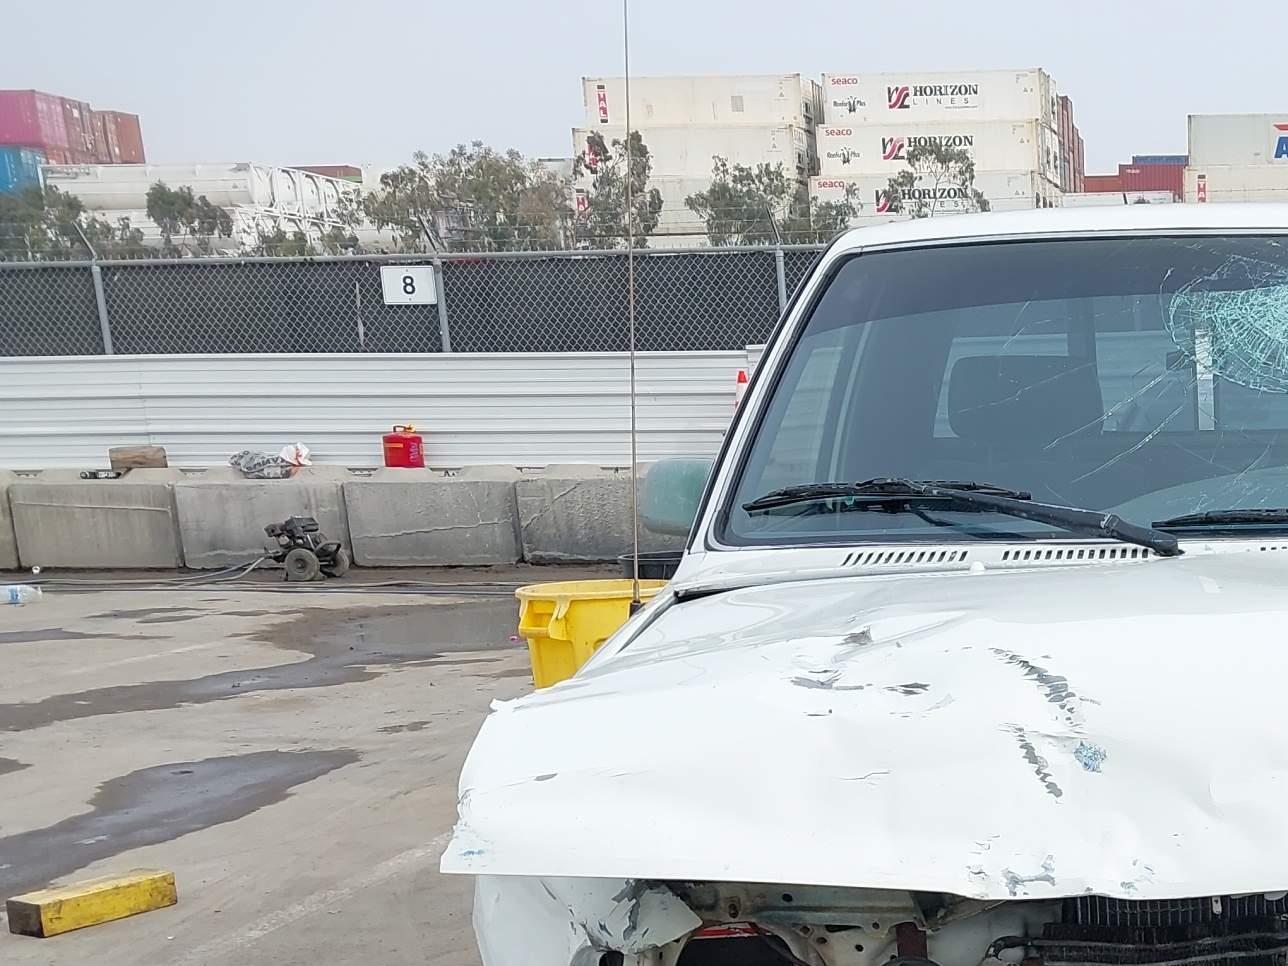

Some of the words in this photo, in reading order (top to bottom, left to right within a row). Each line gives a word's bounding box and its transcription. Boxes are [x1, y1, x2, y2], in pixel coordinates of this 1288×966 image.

[912, 84, 978, 97] HORIZON
[913, 97, 969, 105] LINES
[825, 128, 852, 136] seaco
[907, 136, 974, 147] HORIZON
[402, 275, 416, 295] 8
